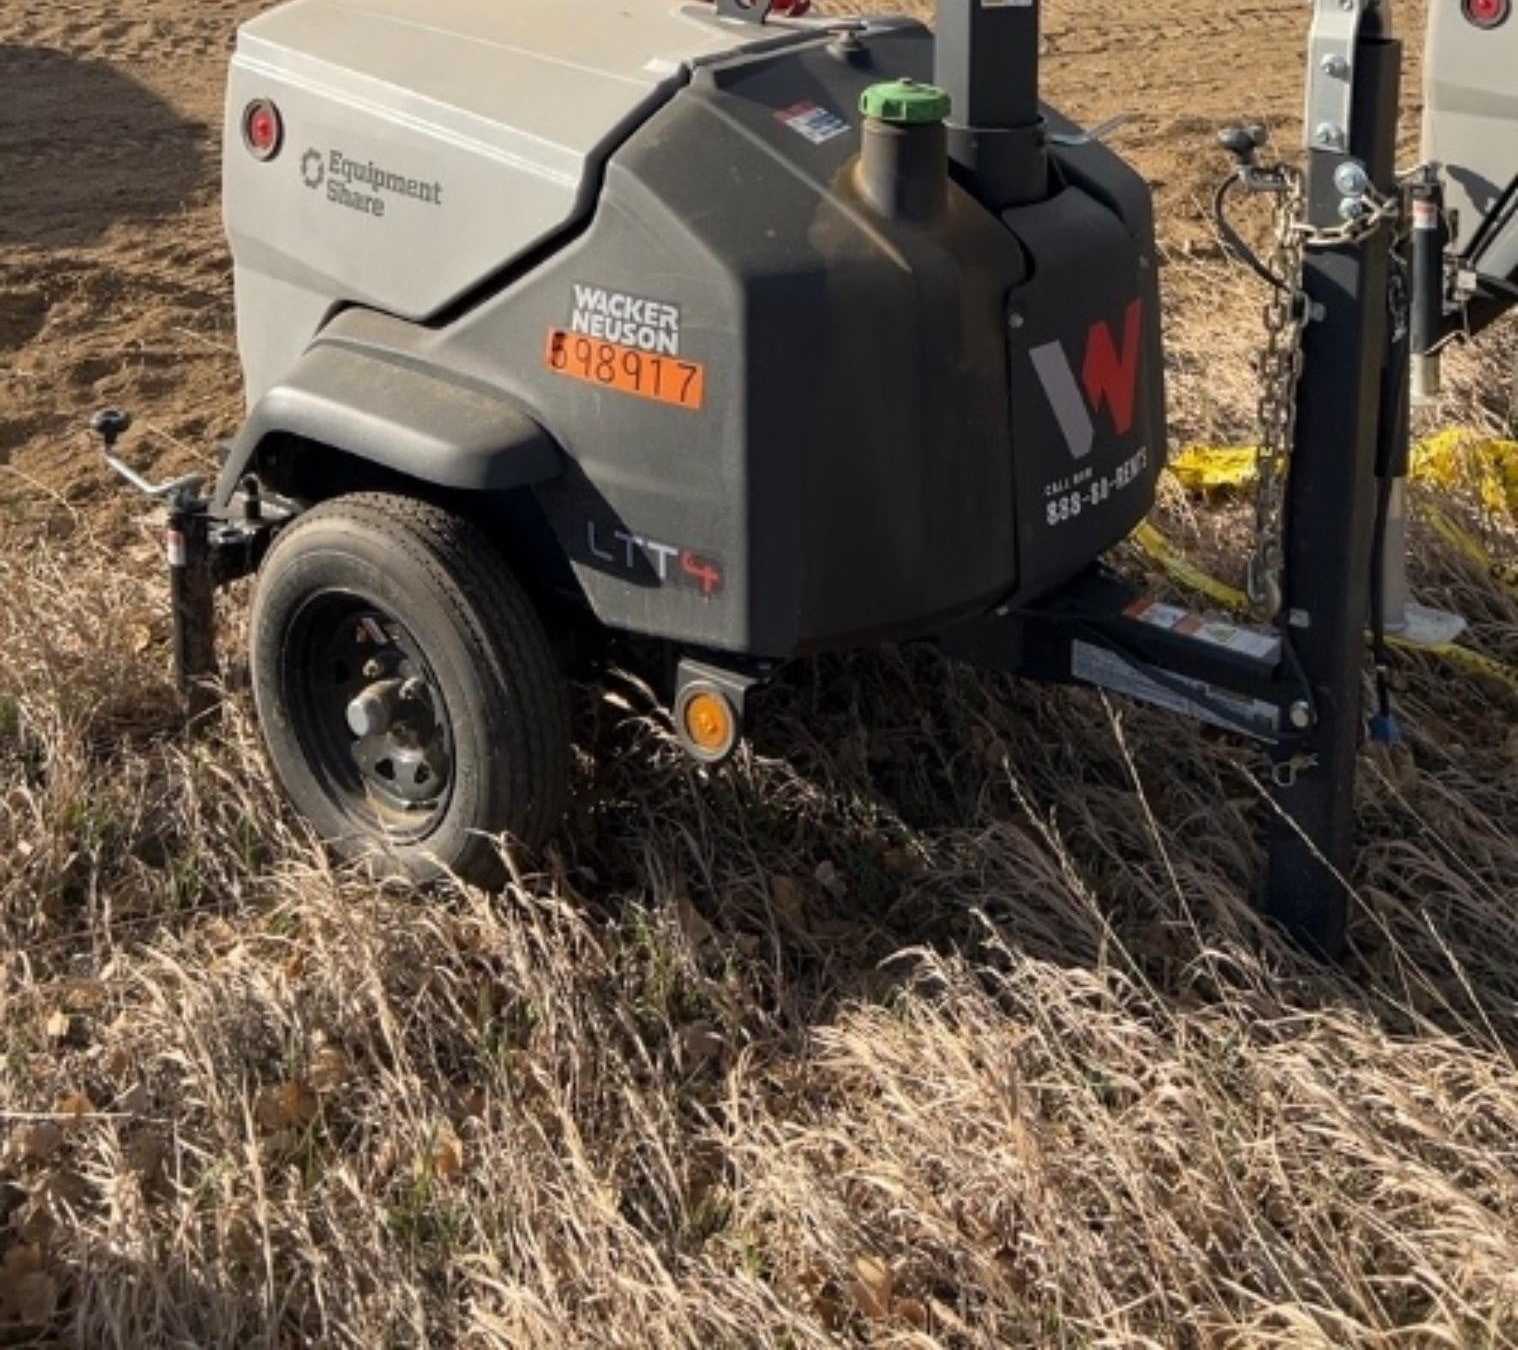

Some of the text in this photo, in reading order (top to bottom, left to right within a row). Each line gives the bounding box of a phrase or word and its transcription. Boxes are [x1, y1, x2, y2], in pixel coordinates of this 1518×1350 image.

[326, 179, 385, 216] Share
[329, 149, 442, 204] Equipment
[573, 284, 679, 330] WACKER
[572, 309, 679, 355] NEUSON
[587, 518, 719, 595] LTT4
